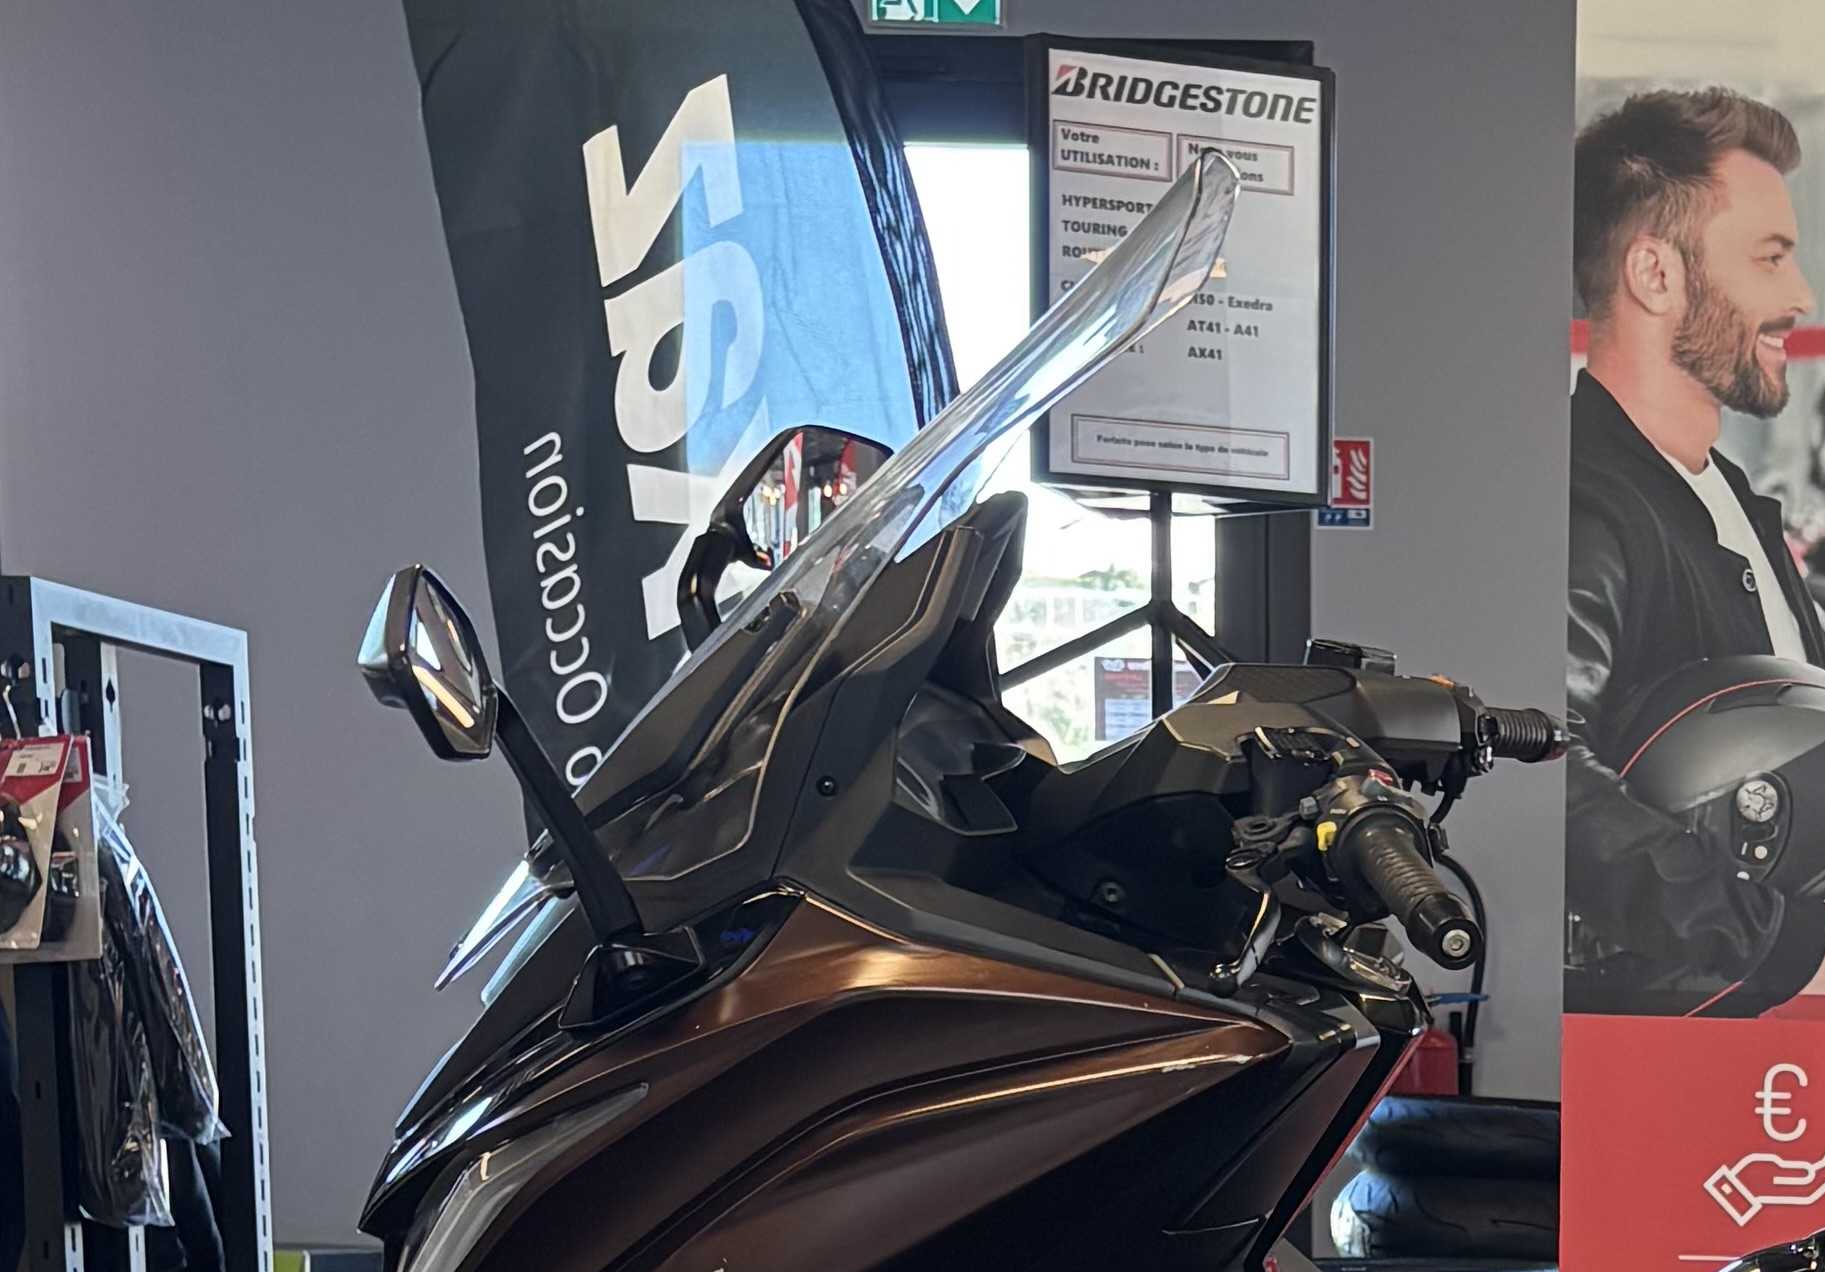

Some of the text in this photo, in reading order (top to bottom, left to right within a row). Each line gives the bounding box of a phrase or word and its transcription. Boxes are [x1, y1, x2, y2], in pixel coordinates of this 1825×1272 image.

[1051, 64, 1317, 124] BRIDGESTONE
[1061, 128, 1101, 145] Votre
[1061, 220, 1129, 238] TOURING
[1186, 319, 1222, 335] AT41
[1233, 324, 1260, 337] A41
[1187, 345, 1223, 361] AX41
